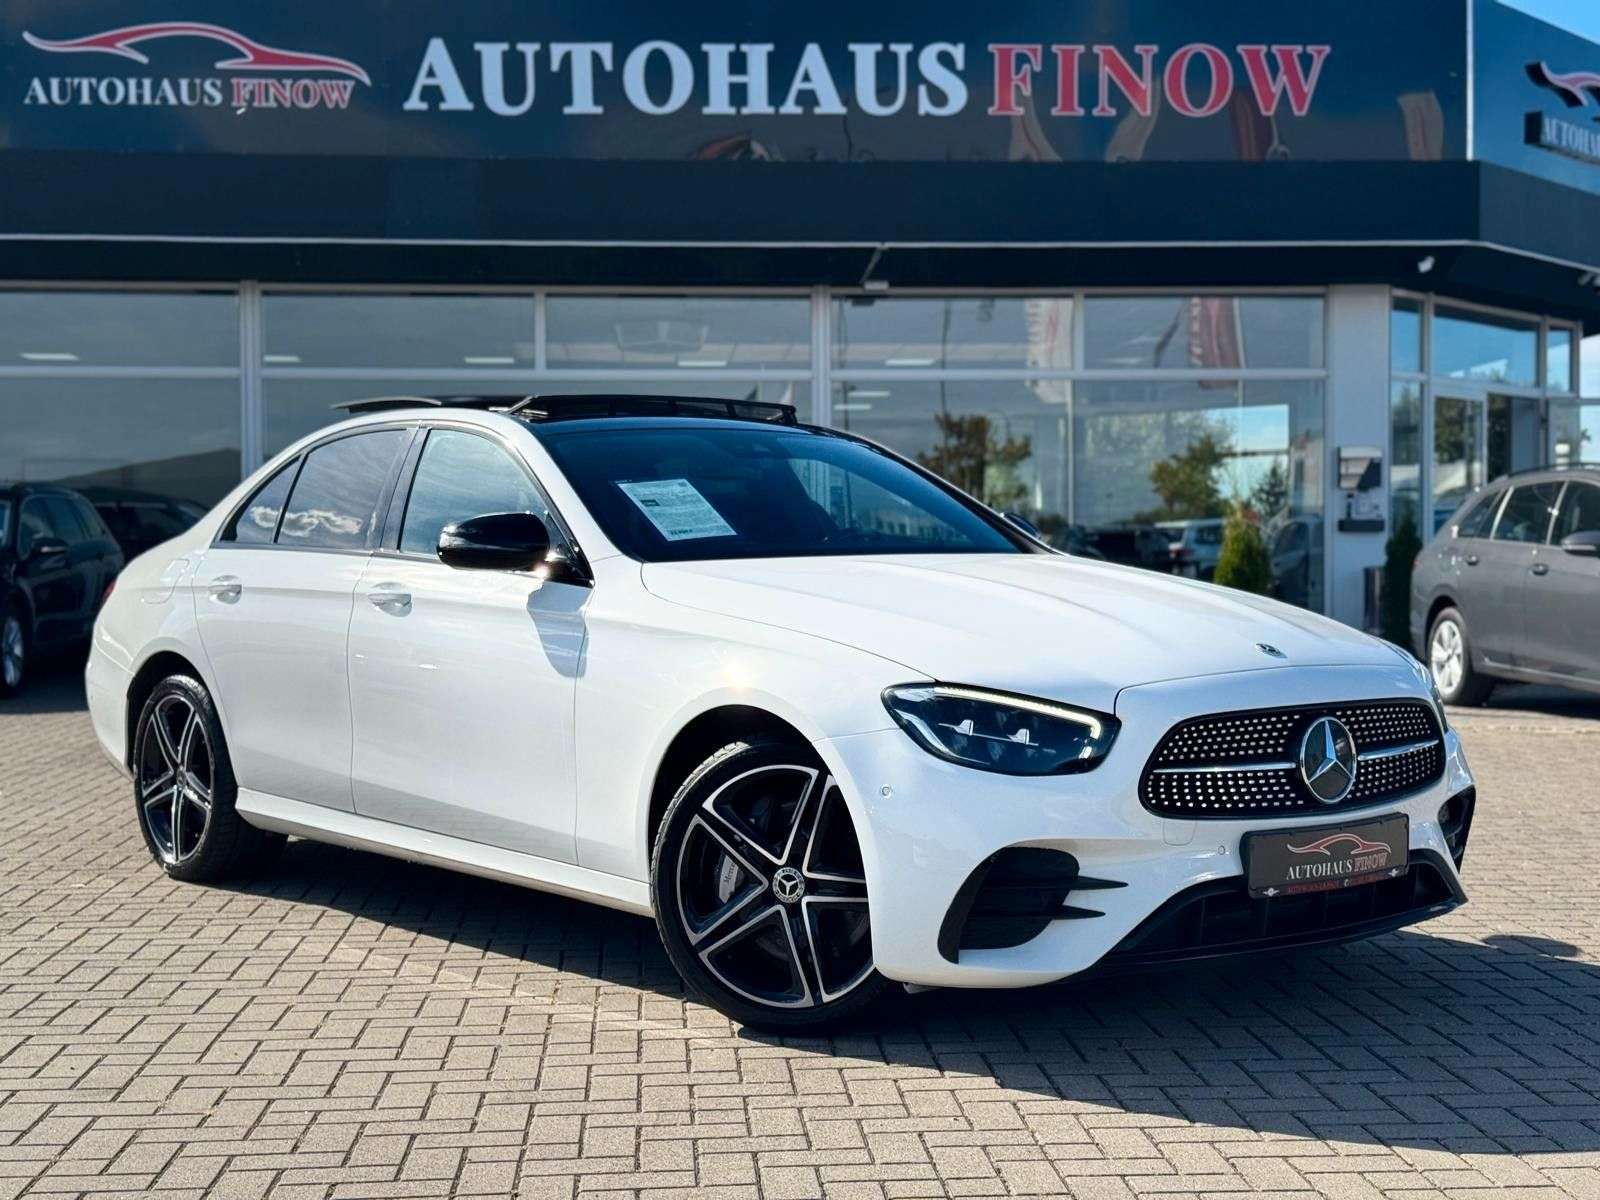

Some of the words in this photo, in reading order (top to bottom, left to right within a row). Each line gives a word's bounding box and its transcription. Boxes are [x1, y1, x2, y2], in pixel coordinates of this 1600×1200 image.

[24, 76, 223, 106] AUTOHAUS
[230, 77, 355, 108] FINOW
[404, 38, 968, 116] AUTOHAUS
[987, 43, 1331, 118] FINOW
[1286, 859, 1353, 880] AUTOHAUS
[1353, 852, 1388, 872] FINOW
